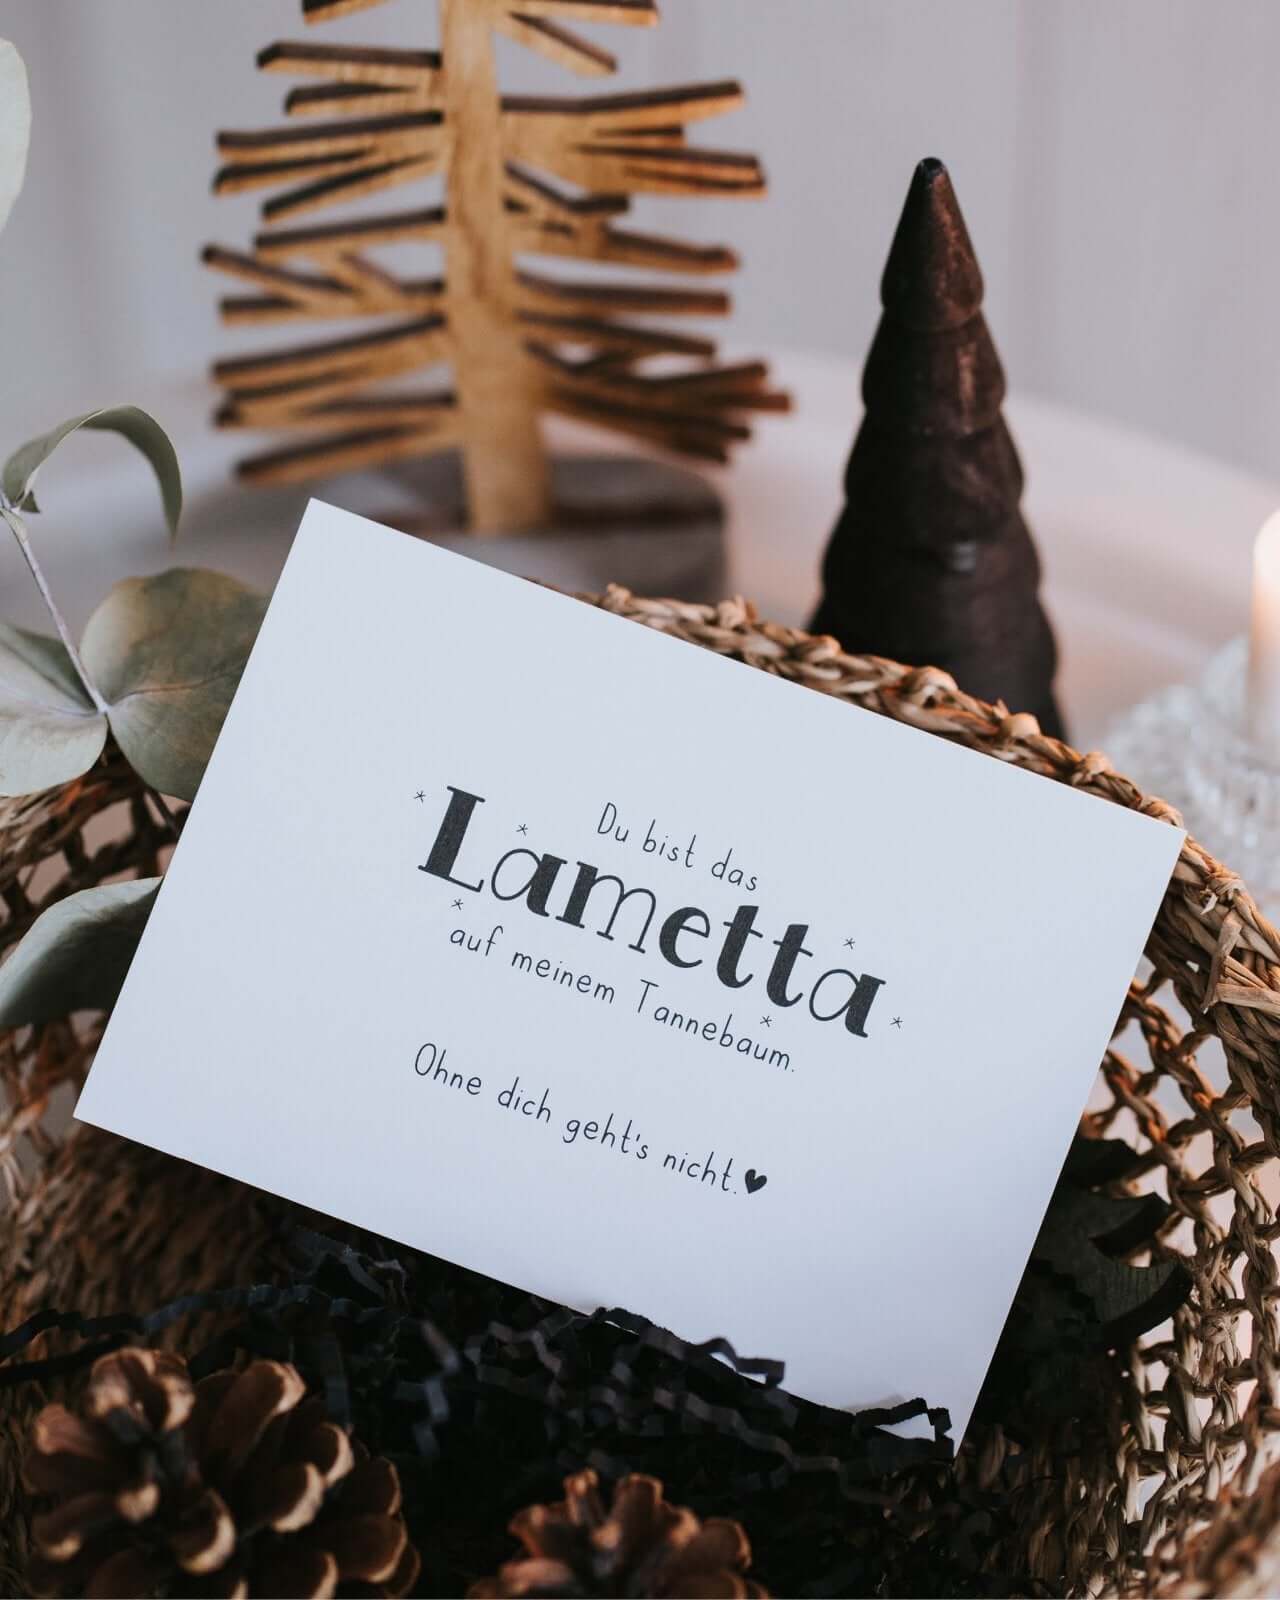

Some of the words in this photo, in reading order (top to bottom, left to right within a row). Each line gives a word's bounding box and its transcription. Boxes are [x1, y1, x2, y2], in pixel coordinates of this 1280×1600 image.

[417, 785, 887, 1039] Lametta
[597, 802, 630, 843] Du
[642, 819, 697, 868] bist
[711, 847, 758, 892] das
[450, 925, 504, 957] auf
[511, 951, 615, 1004] meinem
[637, 978, 796, 1073] Tannebaum.
[414, 1042, 482, 1096] Ohne
[497, 1076, 552, 1123] dich
[562, 1112, 649, 1160] geht's
[663, 1151, 738, 1195] nicht.
